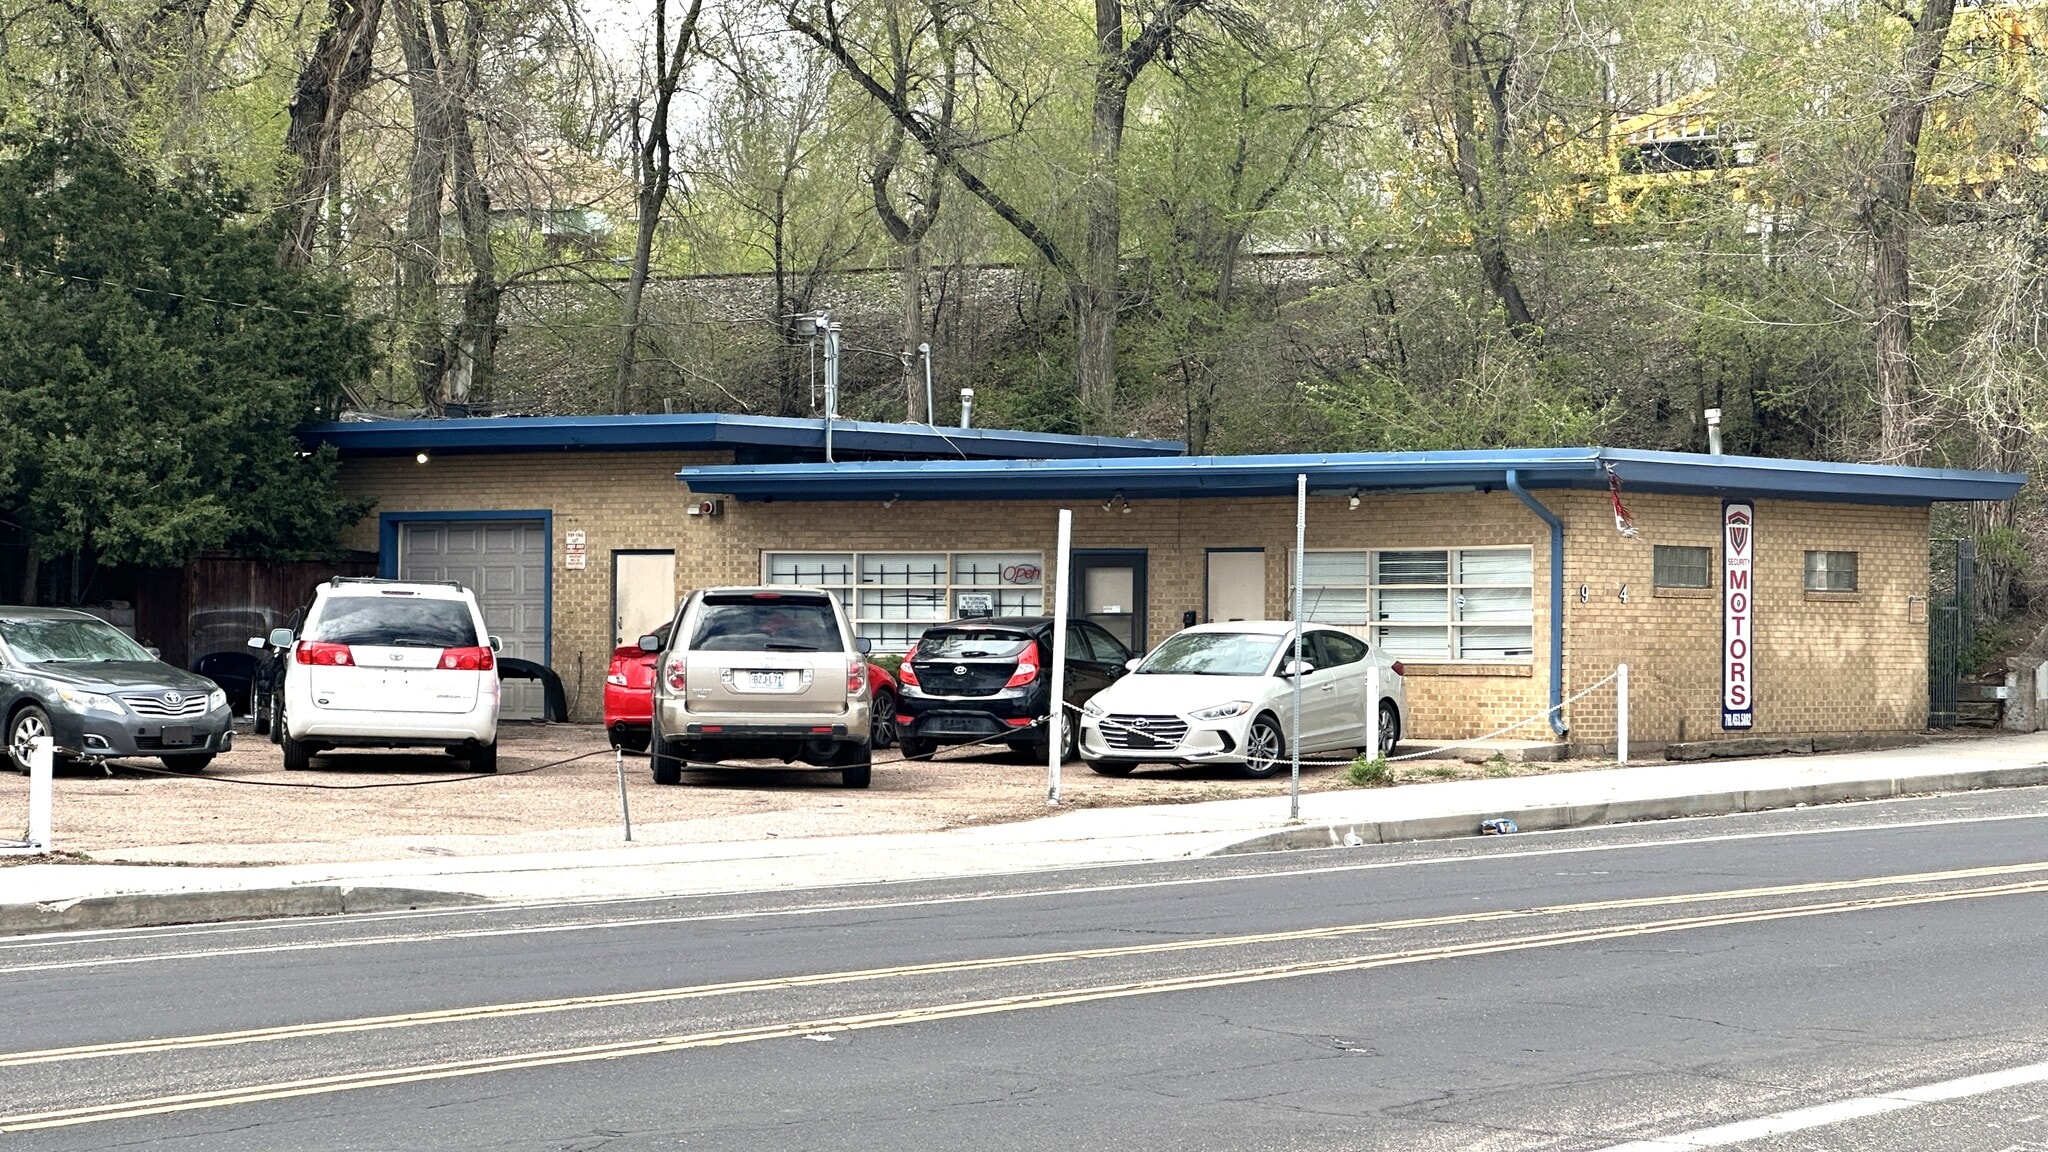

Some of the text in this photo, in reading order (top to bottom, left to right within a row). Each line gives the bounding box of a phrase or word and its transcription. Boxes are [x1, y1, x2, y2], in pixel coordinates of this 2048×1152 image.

[1728, 558, 1750, 566] SECURITY
[1003, 565, 1040, 583] Open
[1580, 584, 1589, 603] 9
[1618, 584, 1629, 604] 4
[1730, 570, 1747, 706] MOTORS
